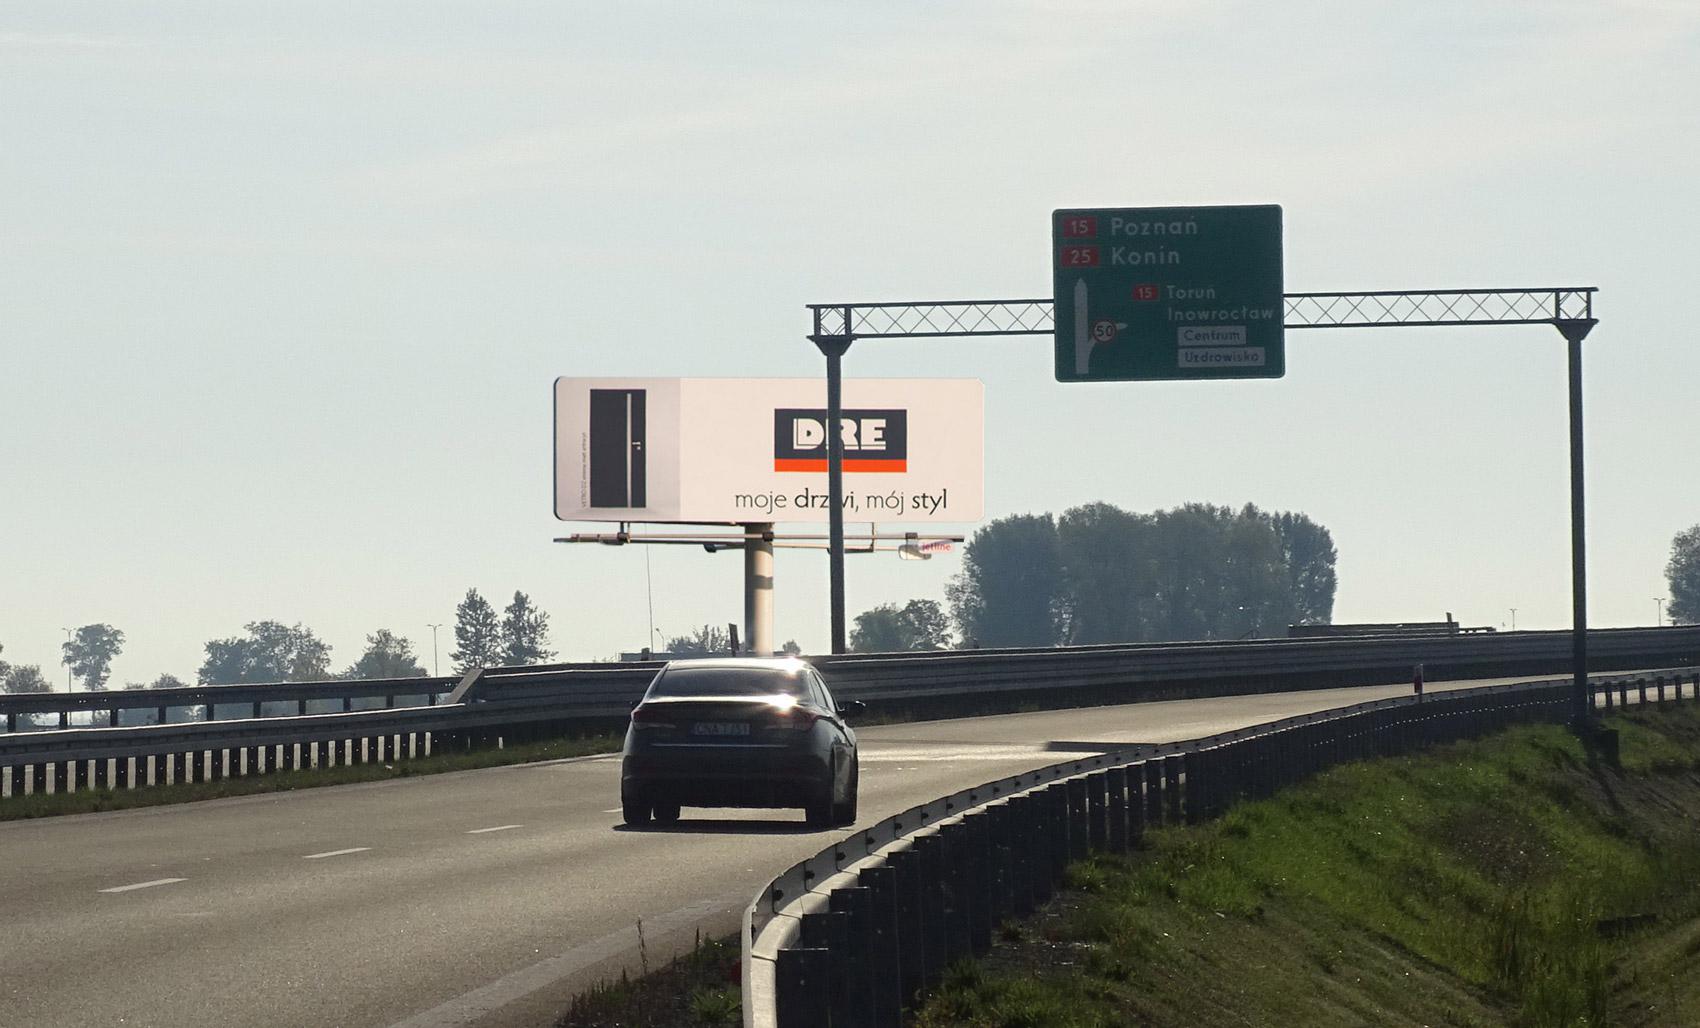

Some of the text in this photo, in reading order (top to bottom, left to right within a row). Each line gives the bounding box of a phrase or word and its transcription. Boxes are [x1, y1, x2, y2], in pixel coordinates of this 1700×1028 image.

[1070, 219, 1089, 235] 15
[1110, 216, 1198, 236] Poznań
[1070, 249, 1091, 265] 25
[1111, 246, 1181, 265] Konin
[1138, 287, 1153, 300] 15
[1096, 324, 1115, 338] 50
[1183, 329, 1241, 342] Centrum
[1184, 350, 1260, 364] Uzdrowisko
[792, 417, 887, 451] DRE
[735, 490, 787, 515] moje
[866, 490, 905, 516] mój
[911, 488, 947, 515] styl
